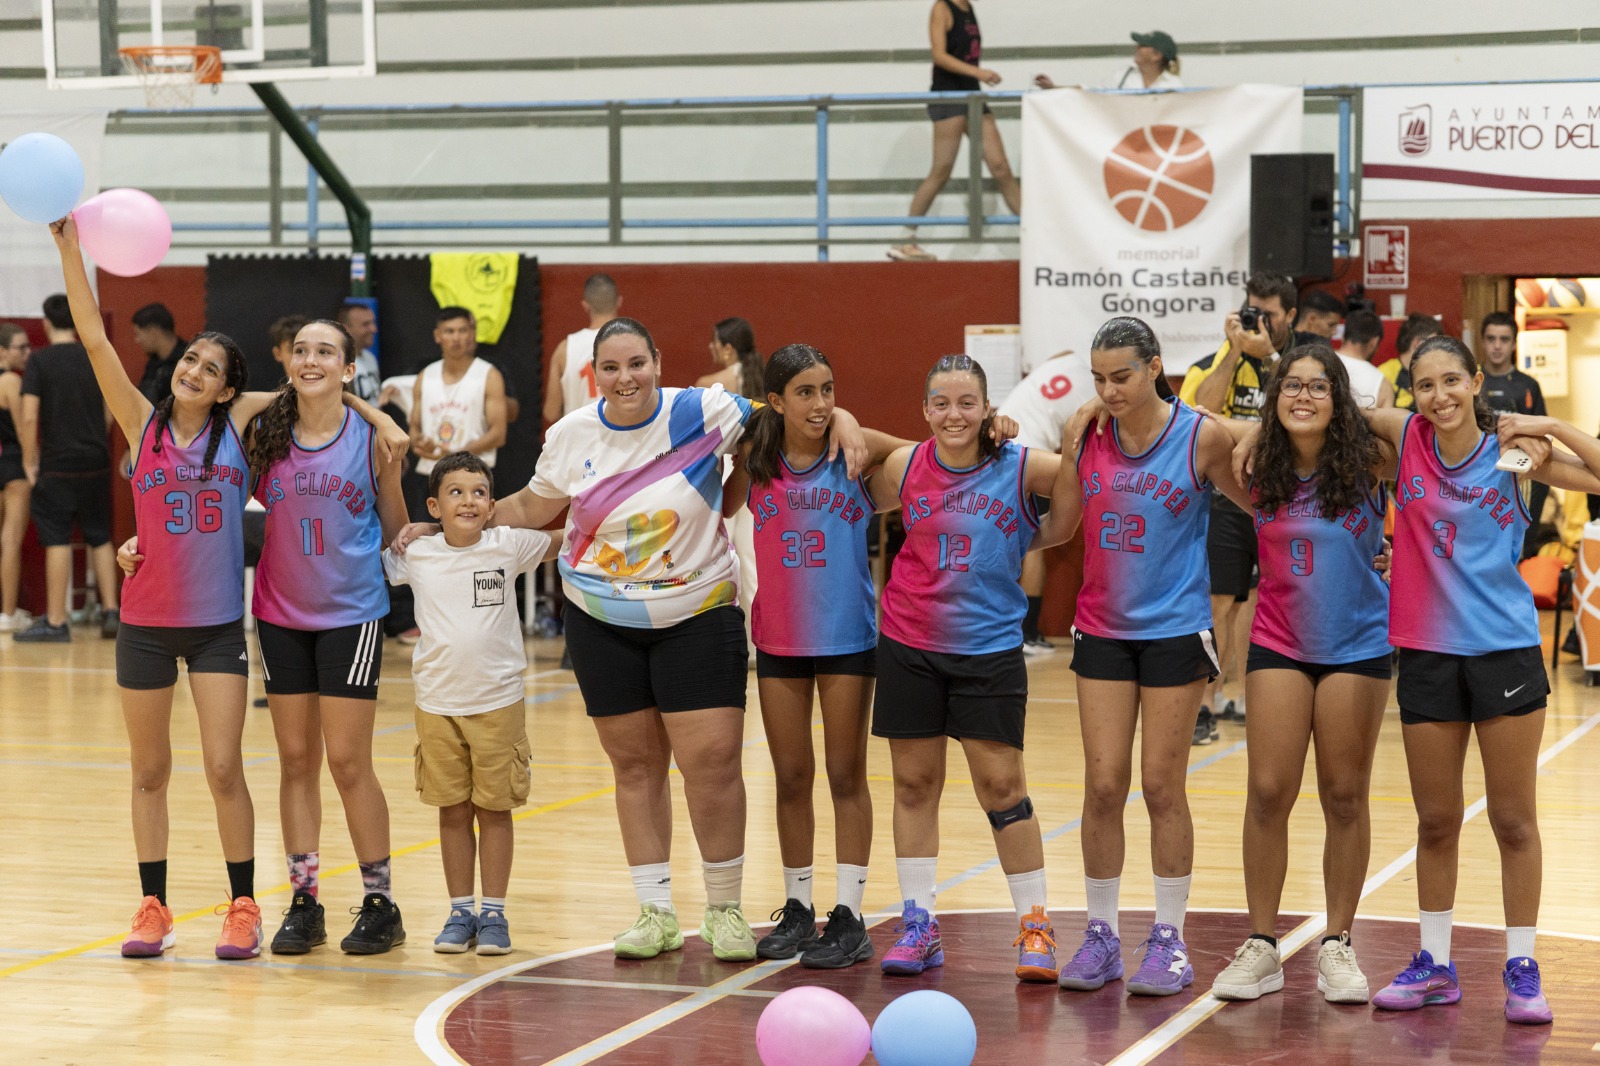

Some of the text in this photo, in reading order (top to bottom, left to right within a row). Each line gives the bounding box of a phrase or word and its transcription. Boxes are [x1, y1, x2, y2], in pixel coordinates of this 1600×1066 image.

[1449, 123, 1599, 151] PUERTO DEL
[1118, 245, 1200, 261] memorial
[1035, 267, 1122, 286] Ramón
[1102, 292, 1216, 318] Góngora
[137, 468, 167, 494] LAS
[295, 472, 366, 519] CLIPPER
[1112, 471, 1190, 518] CLIPPER
[165, 489, 222, 534] 36
[754, 487, 864, 532] LAS CLIPPER
[943, 491, 1019, 539] CLIPPER
[1439, 478, 1515, 531] CLIPPER
[301, 518, 324, 555] 11
[781, 530, 826, 568] 32
[1099, 511, 1146, 553] 22
[1433, 519, 1457, 559] 3
[938, 533, 971, 572] 12
[1290, 537, 1314, 577] 9
